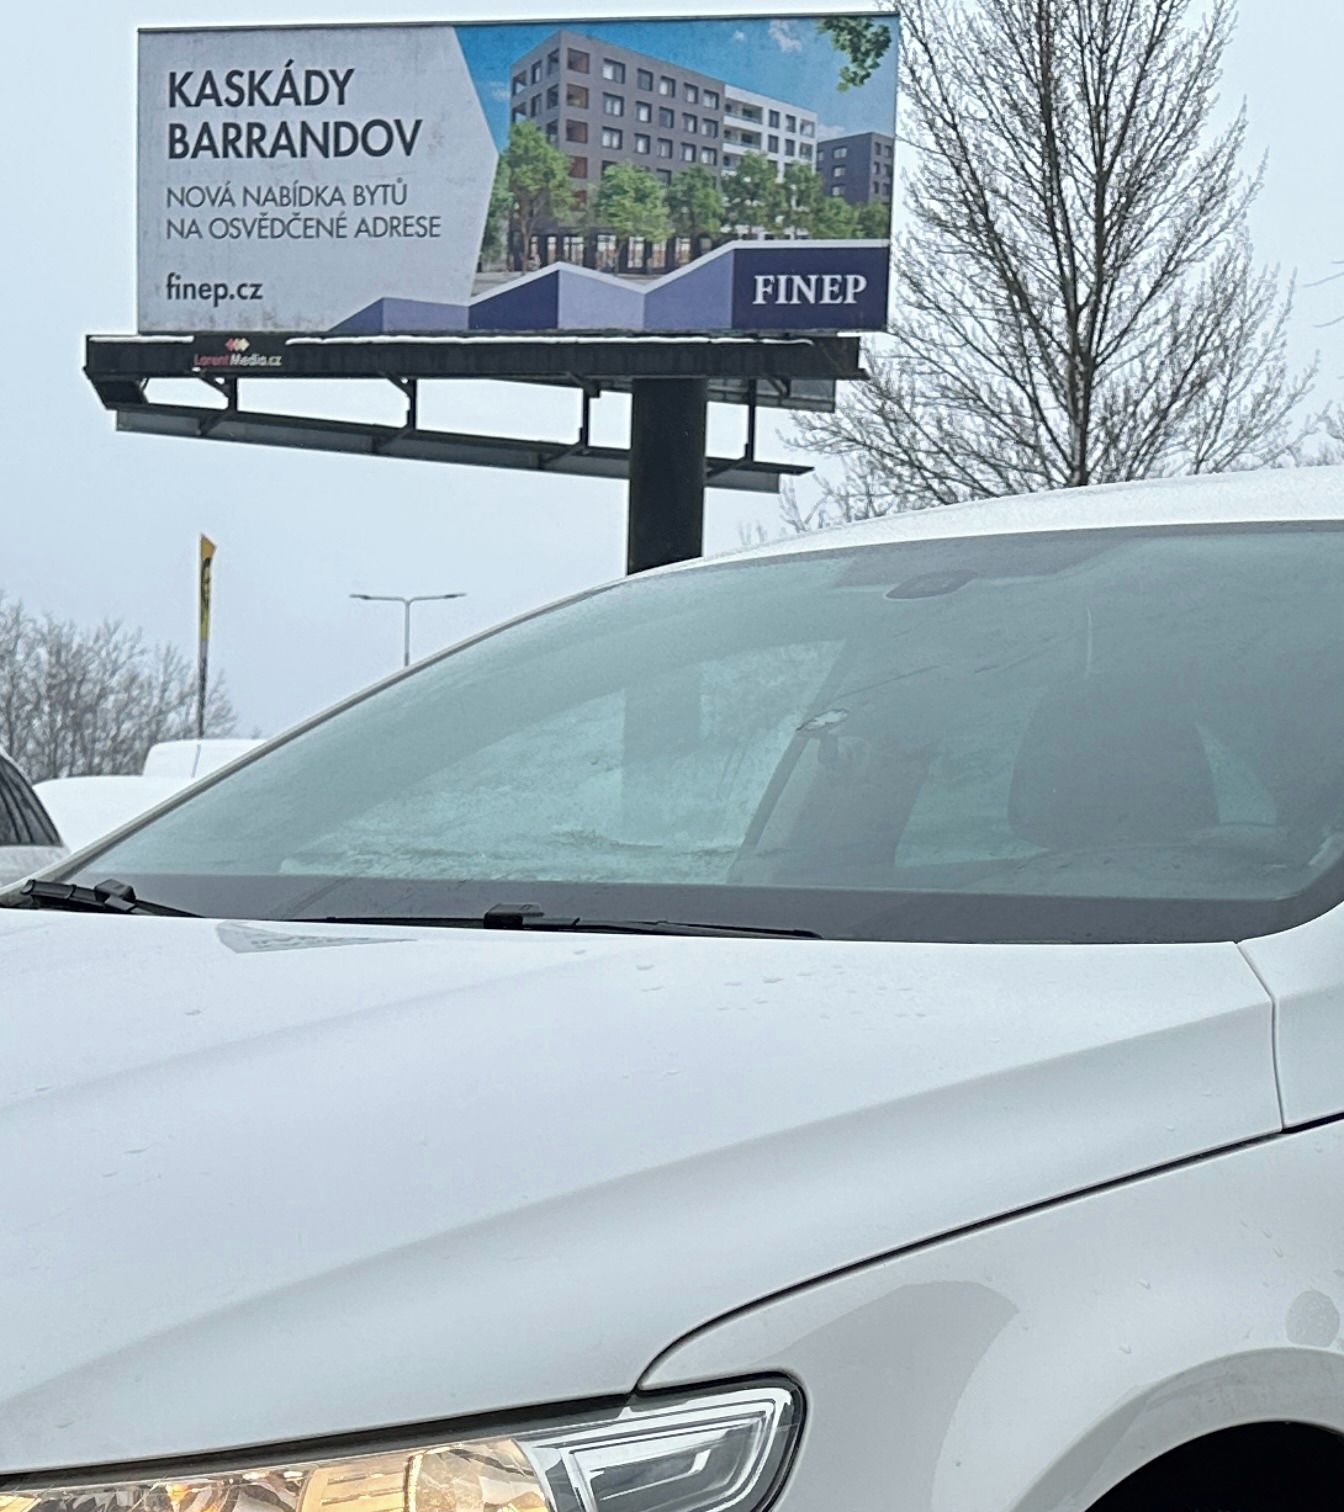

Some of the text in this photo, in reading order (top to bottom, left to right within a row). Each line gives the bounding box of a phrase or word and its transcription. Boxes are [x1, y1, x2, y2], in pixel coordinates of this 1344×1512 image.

[168, 58, 355, 108] KASKÁDY
[168, 118, 423, 159] BARRANDOV
[166, 177, 408, 208] NOVÁ NABÍDKA BYTŮ
[166, 210, 442, 240] NA OSVĚDČENÉ ADRESE
[165, 272, 264, 308] finep.cz
[752, 274, 868, 305] FINEP
